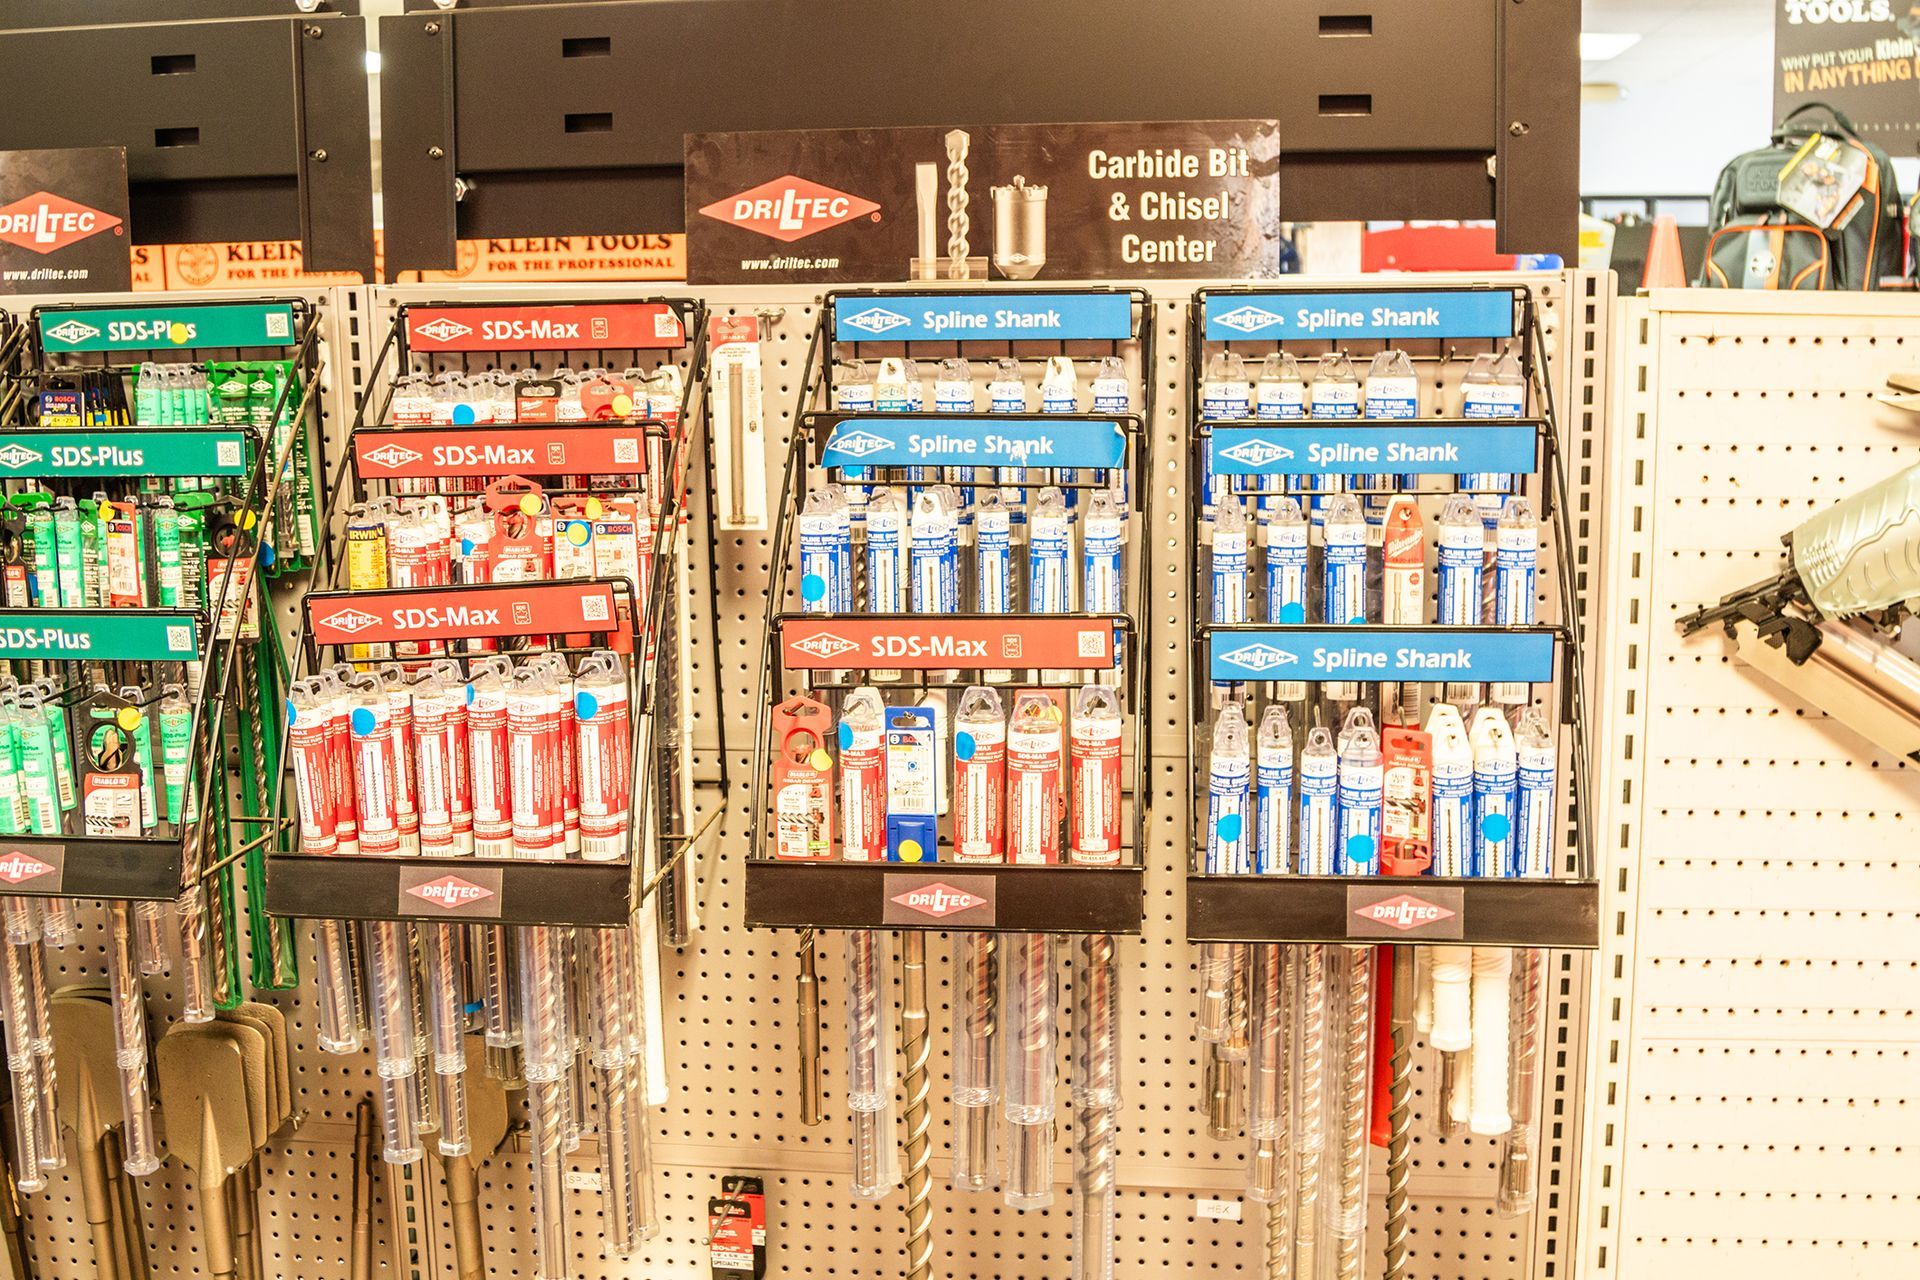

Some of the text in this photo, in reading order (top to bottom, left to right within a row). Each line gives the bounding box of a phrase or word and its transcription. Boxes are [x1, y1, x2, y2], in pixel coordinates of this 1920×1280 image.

[1785, 0, 1896, 24] TOOLS.
[1781, 55, 1811, 71] WHY
[1812, 51, 1836, 68] PUT
[1838, 47, 1874, 65] YOUR
[1783, 69, 1805, 93] IN
[1808, 58, 1912, 91] ANYTHING
[1089, 147, 1250, 179] Carbide Bit
[734, 189, 849, 230] DRILTEC
[1109, 187, 1230, 221] & Chisel
[0, 204, 95, 243] DRILTEC
[488, 234, 671, 254] KLEIN TOOLS
[1122, 234, 1217, 263] Center
[3, 268, 88, 282] www.driltec.com
[227, 269, 256, 280] FOR
[260, 267, 290, 279] THE
[488, 257, 674, 272] FOR THE PROFESSIONAL
[741, 256, 839, 271] www.driltec.com
[108, 320, 197, 341] SDS-Pls
[482, 320, 579, 340] SDS-Max
[923, 310, 988, 333] Spline
[996, 309, 1061, 328] Shank
[1297, 309, 1364, 331] Spline
[1371, 307, 1440, 327] Shank
[51, 446, 143, 467] SDS-Plus
[433, 445, 535, 466] SDS-Max
[908, 434, 977, 457] Spline
[985, 434, 1054, 456] Shank
[1308, 444, 1379, 465] Spline
[1386, 442, 1458, 462] Shank
[607, 525, 632, 534] BOSCH
[392, 606, 500, 629] SDS-Max
[0, 628, 91, 649] SDS-Plus
[871, 636, 988, 657] SDS-Max
[1312, 648, 1388, 672] Spline
[1395, 648, 1472, 669] Shank
[0, 857, 42, 878] RILTEC
[421, 881, 481, 902] DRILTEC
[908, 888, 971, 912] DRILTEC
[1372, 900, 1439, 925] DRILTEC
[1207, 1205, 1230, 1214] HEX
